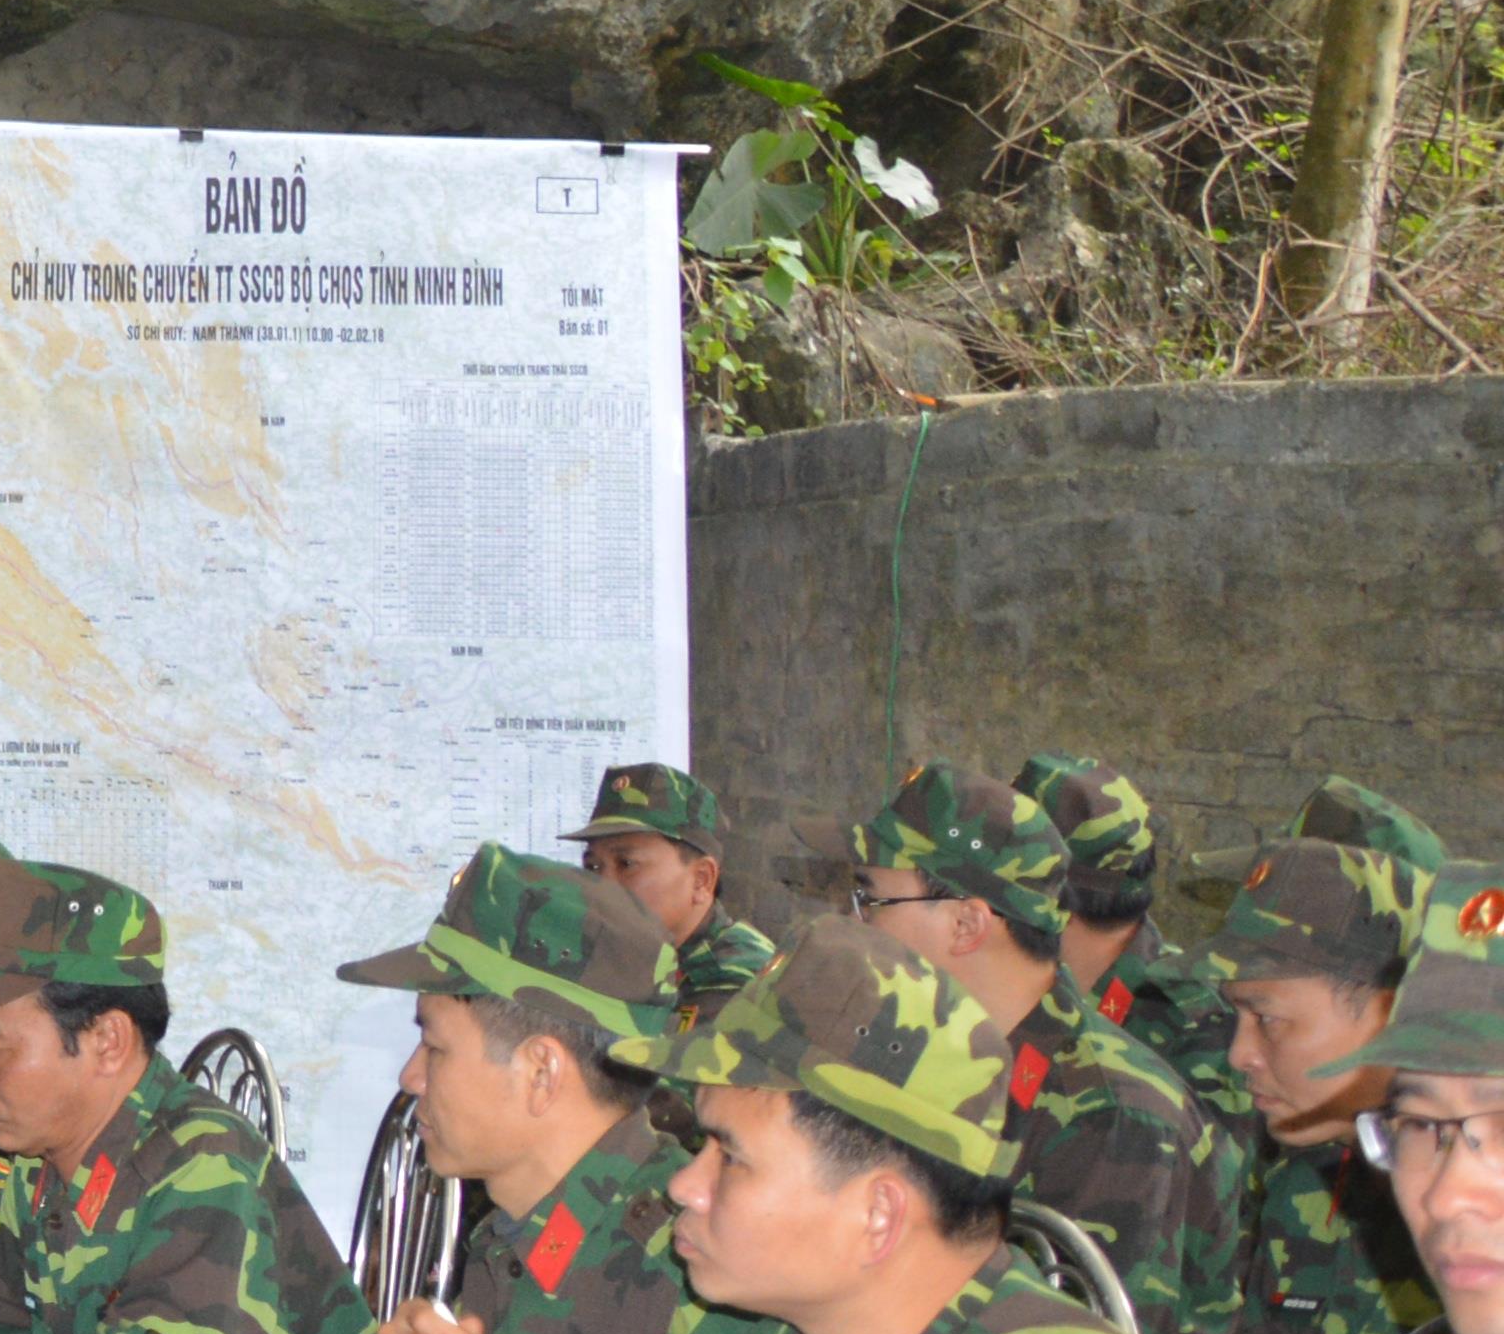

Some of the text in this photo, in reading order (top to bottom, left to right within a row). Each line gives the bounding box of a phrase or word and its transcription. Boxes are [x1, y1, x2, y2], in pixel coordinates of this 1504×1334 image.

[205, 150, 307, 235] BẢN ĐỒ
[563, 188, 572, 207] T
[11, 246, 504, 313] CHỈ HUY TRONG CHUYỂN TT SSCĐ BỘ CHQS TỈNH NINH BÌNH
[192, 325, 217, 341] NAM
[220, 323, 254, 341] THÀNH
[597, 320, 608, 336] 01
